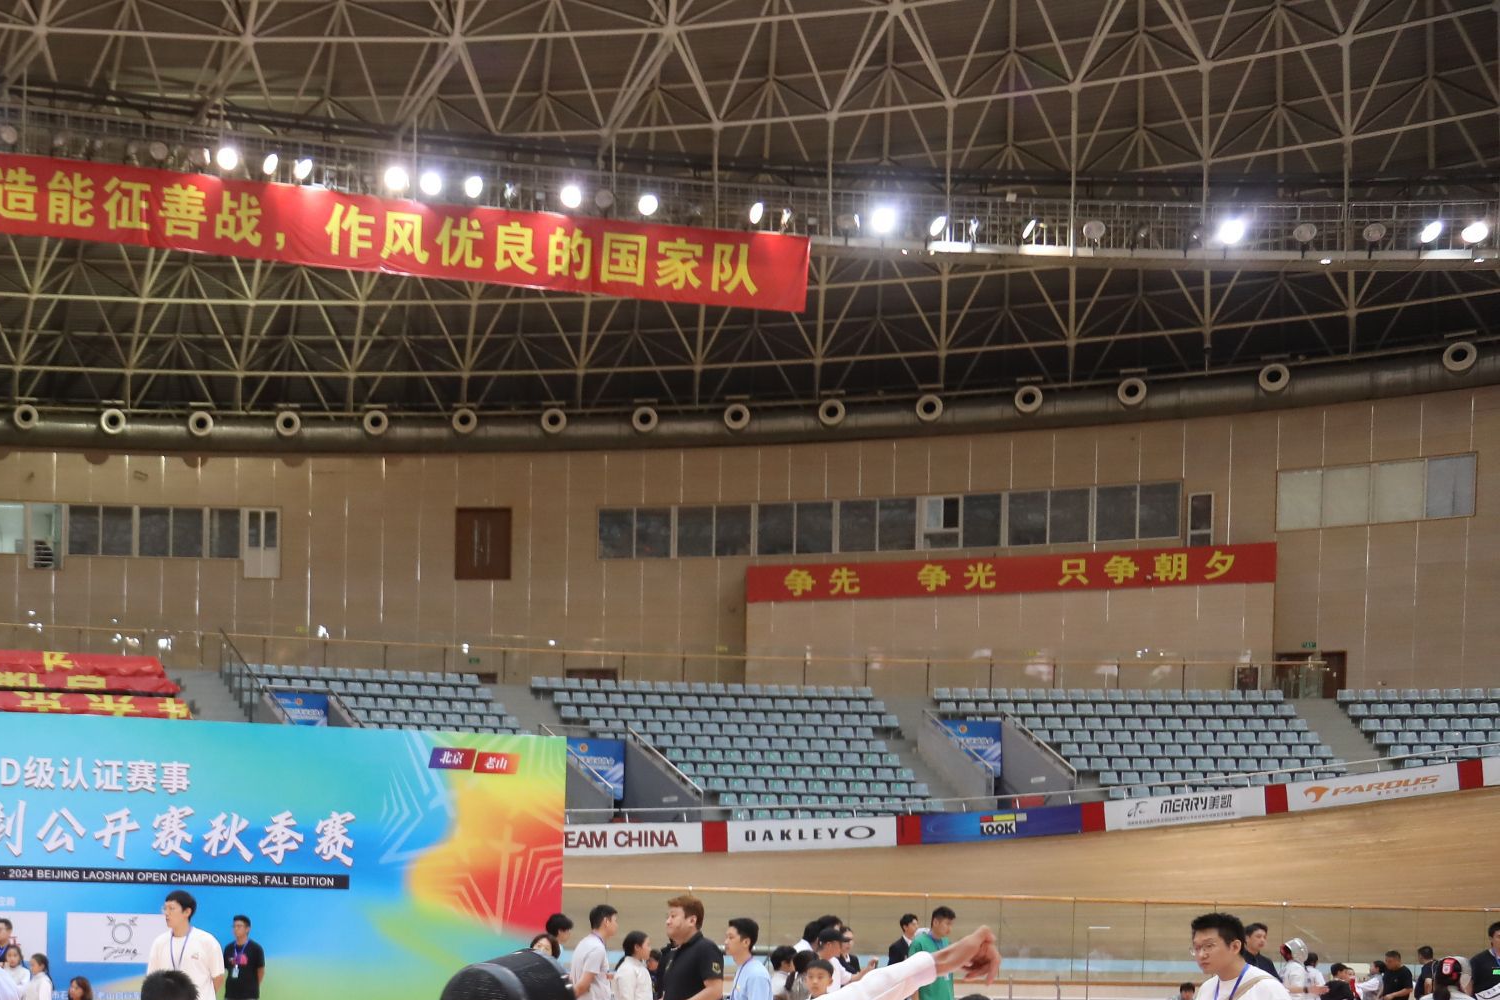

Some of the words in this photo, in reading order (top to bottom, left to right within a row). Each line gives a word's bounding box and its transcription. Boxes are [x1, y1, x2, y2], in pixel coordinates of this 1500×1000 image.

[324, 202, 760, 296] 作风优良的国家队
[784, 567, 861, 597] 争先
[916, 562, 997, 592] 争光
[1057, 550, 1236, 587] 只争朝夕
[439, 751, 464, 765] 北京
[485, 757, 508, 770] 老山
[1332, 774, 1441, 796] PARDUS
[744, 827, 838, 842] OAKLEY
[980, 821, 1014, 836] LOOK
[565, 831, 608, 849] EAM
[614, 830, 678, 847] CHINA
[9, 869, 33, 881] 2024
[37, 869, 79, 882] BEIJING
[83, 870, 133, 883] LAOSHAN
[137, 871, 167, 884] OPEN
[170, 872, 261, 886] CHAMPIONSHIPS,
[265, 874, 289, 886] FALL
[293, 875, 334, 887] EDITION
